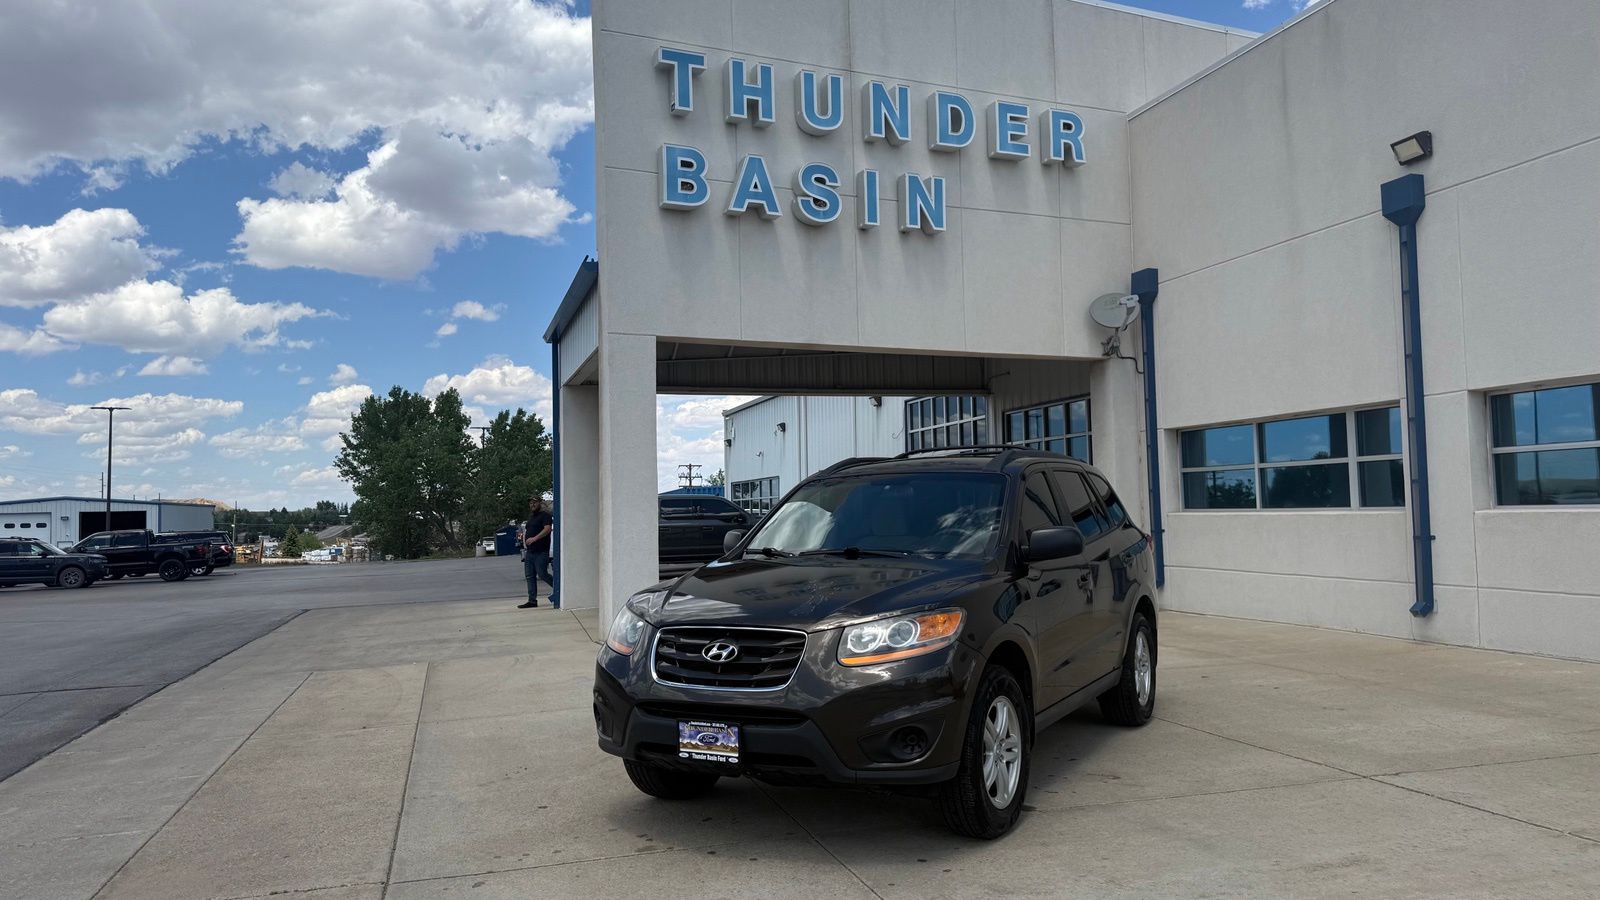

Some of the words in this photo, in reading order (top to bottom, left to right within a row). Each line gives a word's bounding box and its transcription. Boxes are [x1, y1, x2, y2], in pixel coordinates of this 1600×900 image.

[655, 46, 1087, 168] THUNDER
[658, 143, 947, 235] BASIN
[692, 752, 707, 760] Thunder
